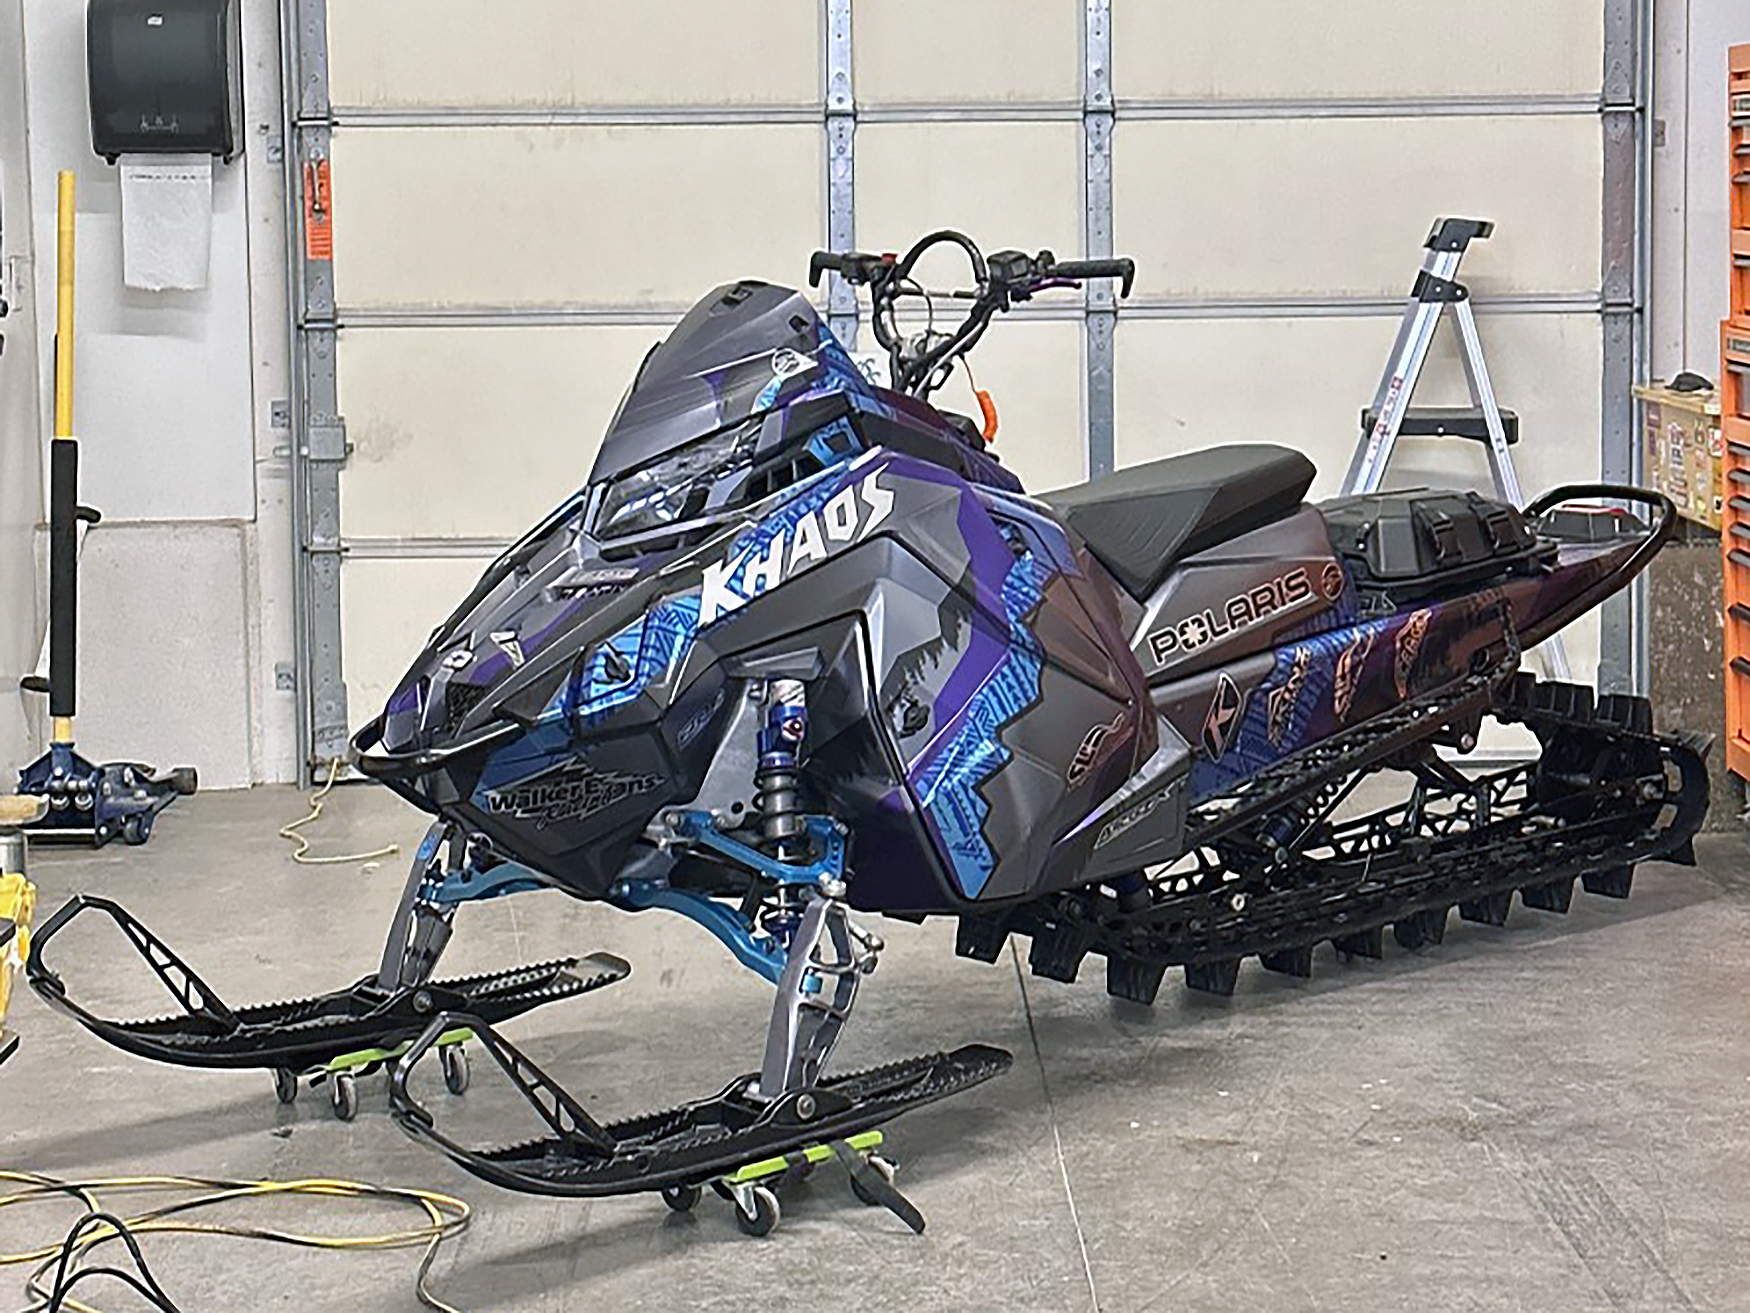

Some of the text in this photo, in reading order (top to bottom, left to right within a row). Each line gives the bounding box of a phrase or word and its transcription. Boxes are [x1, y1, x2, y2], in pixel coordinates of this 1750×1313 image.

[698, 461, 895, 627] KHAOS
[1148, 567, 1313, 666] POLARIS
[488, 779, 584, 814] Walker
